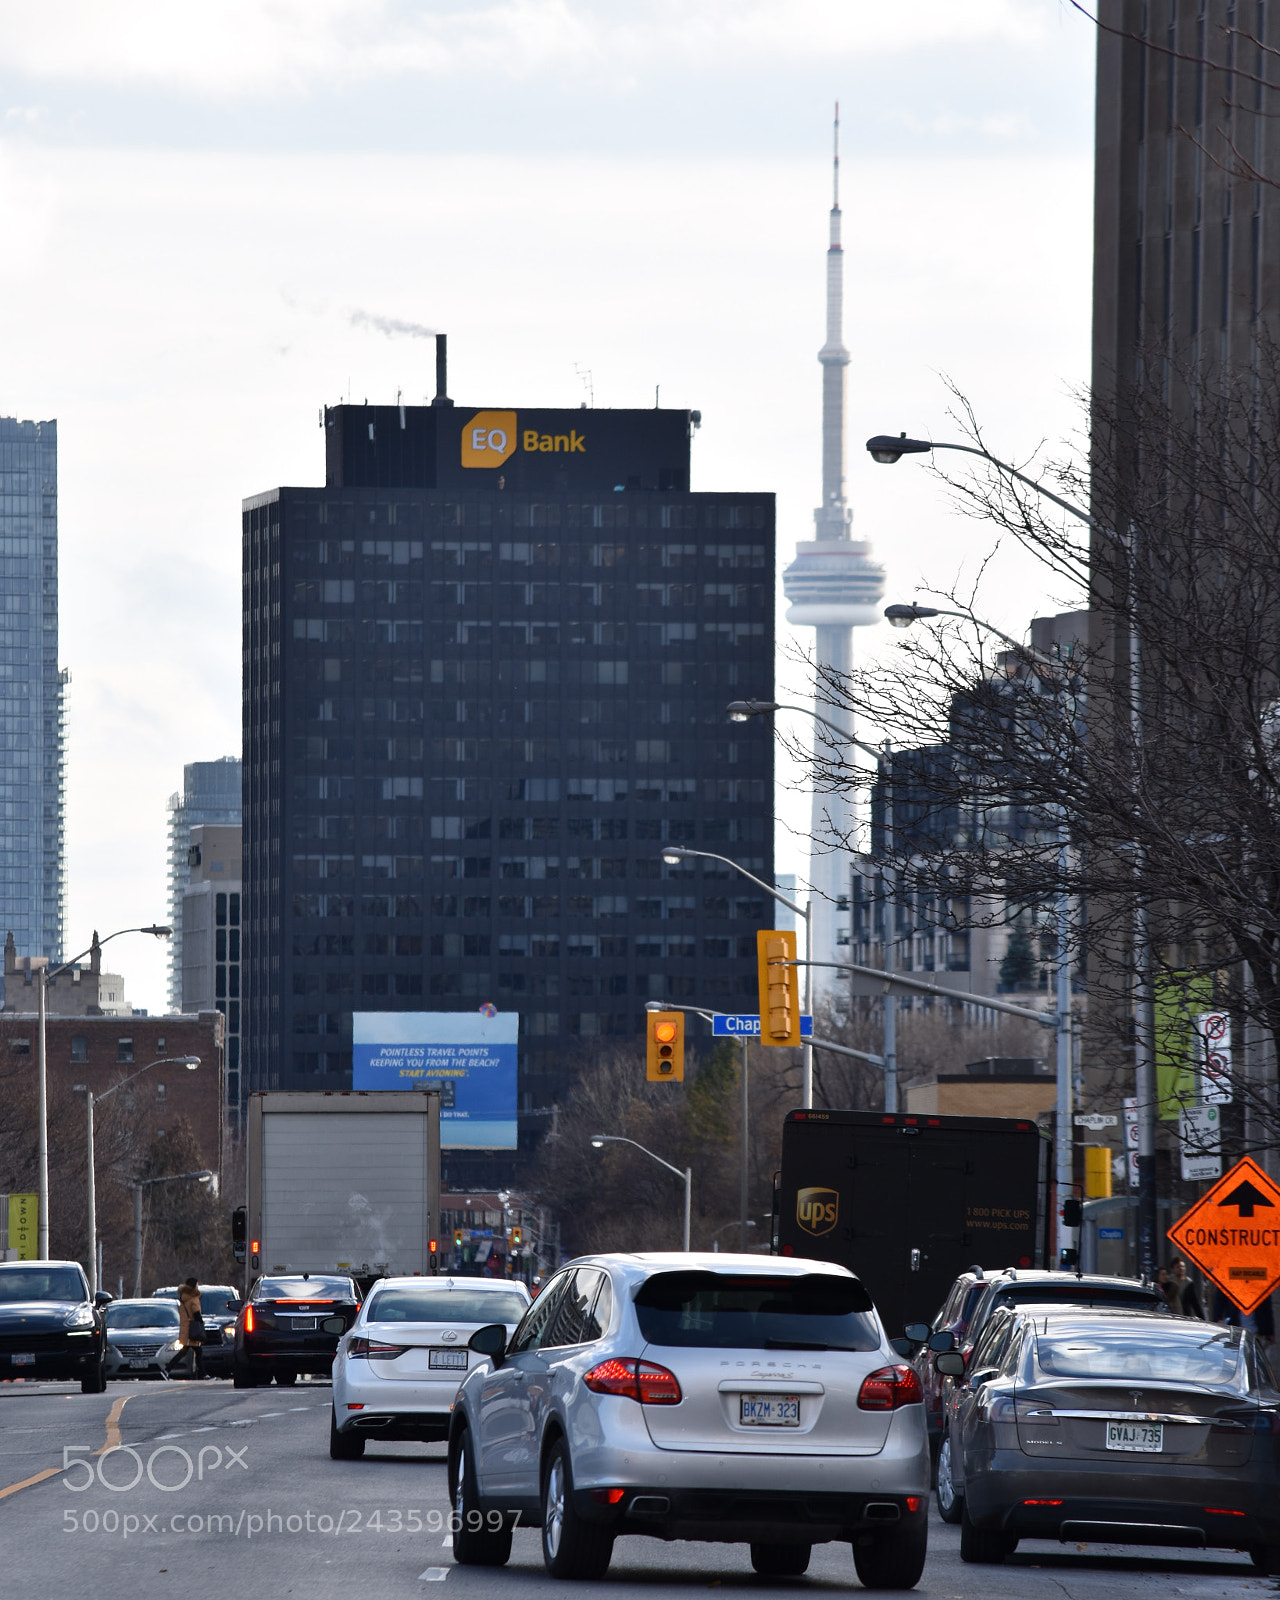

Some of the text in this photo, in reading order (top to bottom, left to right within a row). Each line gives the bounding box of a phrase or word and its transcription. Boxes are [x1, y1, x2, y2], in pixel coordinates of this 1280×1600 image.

[472, 427, 586, 454] EQ Bank
[380, 1048, 489, 1056] POINTLESS TRAVEL POINTS
[369, 1059, 500, 1067] KEEPING YOU FROM THE BEACH?
[399, 1069, 425, 1077] START
[1077, 1116, 1104, 1124] CHAPLIN
[800, 1202, 836, 1229] ups
[973, 1207, 989, 1216] 800
[991, 1208, 1011, 1218] PICK
[1013, 1210, 1030, 1219] UPS
[17, 1198, 29, 1259] MIDTOWN
[966, 1220, 1029, 1231] www.ups.com
[442, 1353, 466, 1365] LETTY
[720, 1361, 822, 1369] PORSCHE
[743, 1401, 797, 1418] BKZM 323
[1110, 1427, 1161, 1443] GVAJ 735
